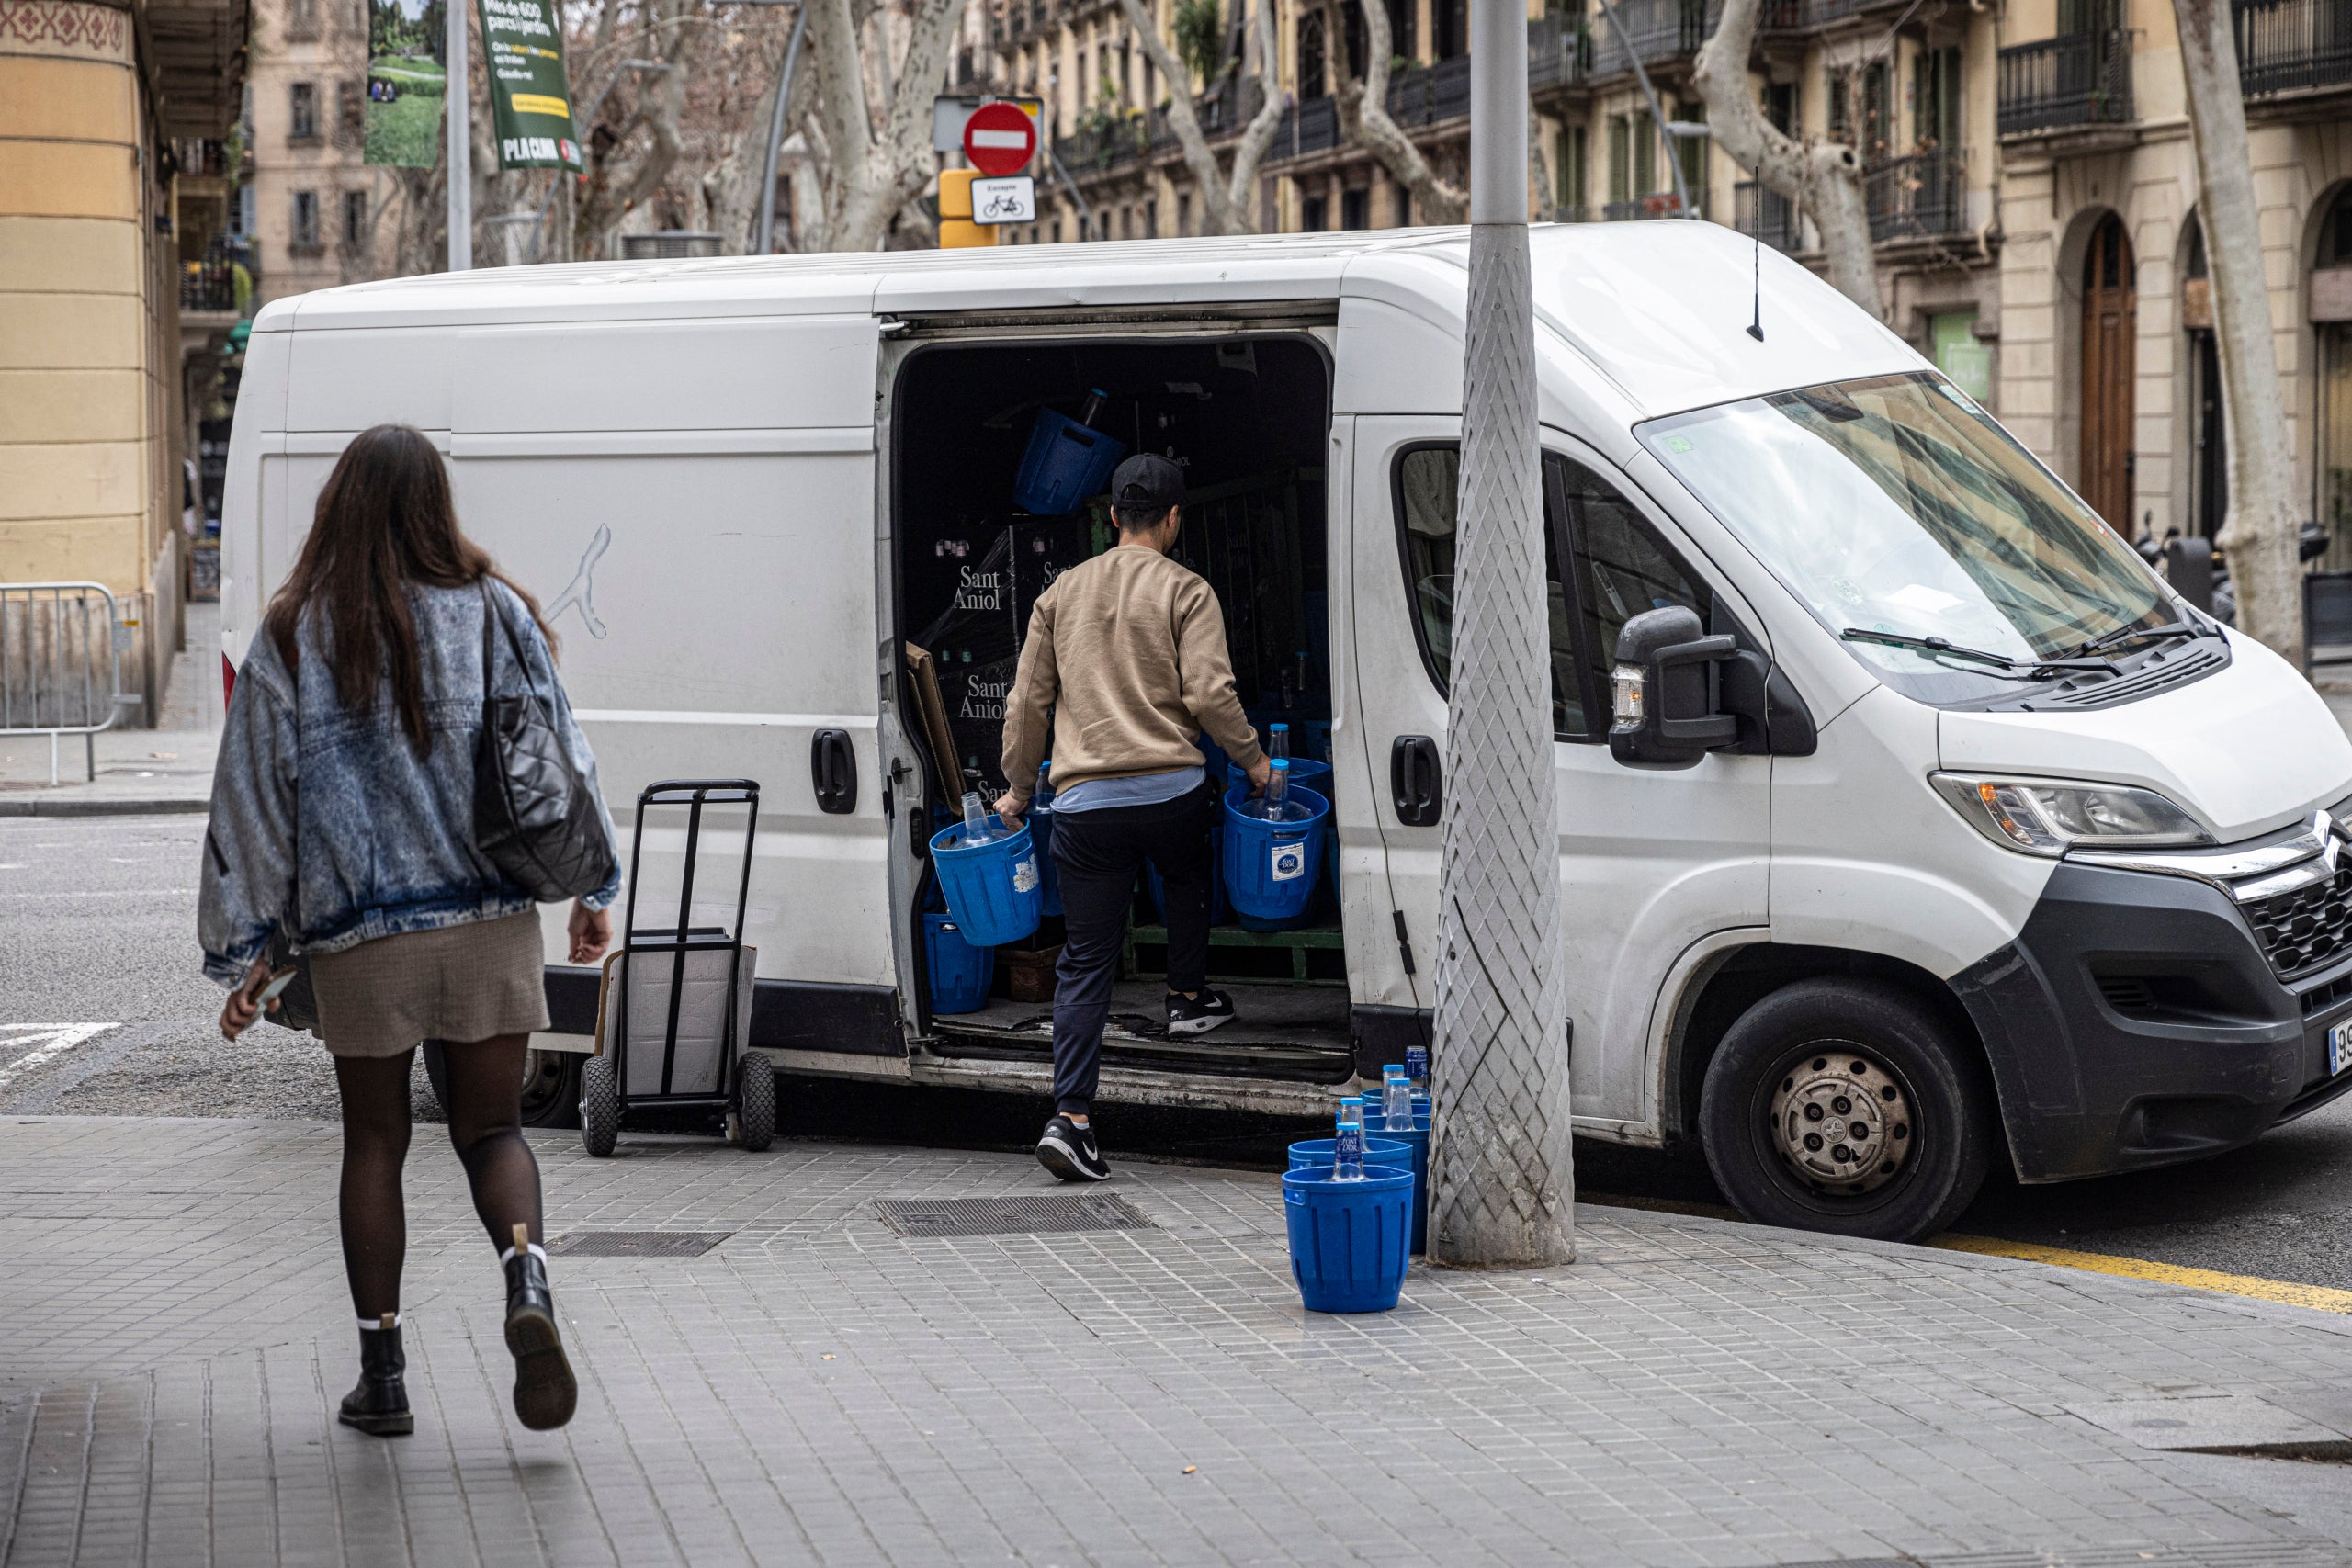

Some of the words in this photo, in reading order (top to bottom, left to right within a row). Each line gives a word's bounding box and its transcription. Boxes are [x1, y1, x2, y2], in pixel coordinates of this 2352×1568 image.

[960, 565, 1001, 589] Sant
[954, 587, 1001, 611] Aniol
[967, 674, 1008, 698] Sant
[959, 695, 1007, 720] Aniol
